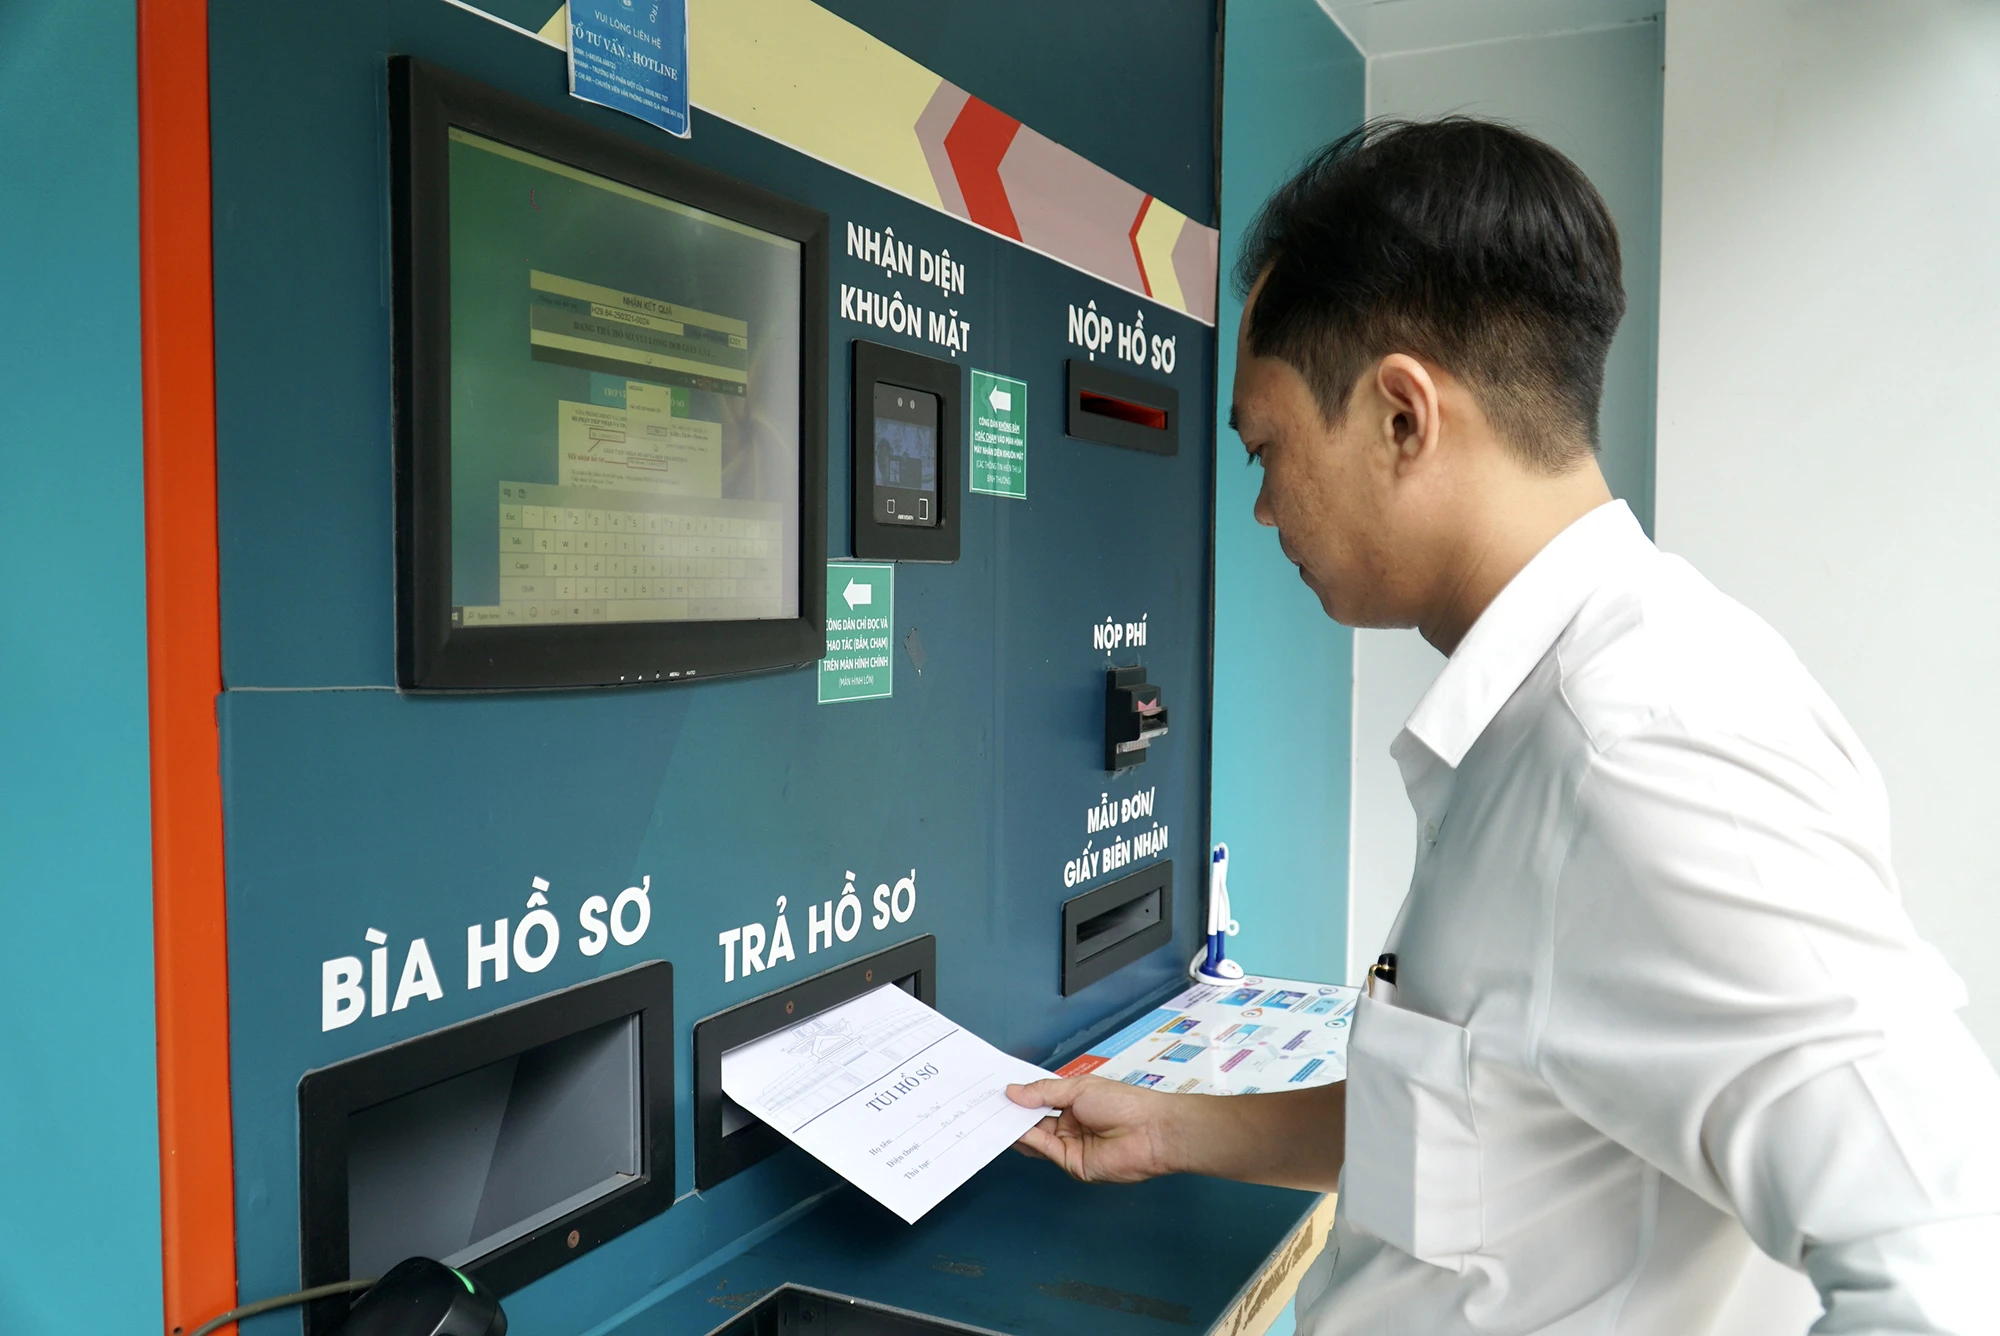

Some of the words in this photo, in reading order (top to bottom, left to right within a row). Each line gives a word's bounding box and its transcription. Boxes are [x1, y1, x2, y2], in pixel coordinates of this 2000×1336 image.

[594, 10, 608, 24] VUI
[610, 16, 632, 35] LÒNG
[633, 27, 650, 43] LIÊN
[586, 30, 602, 47] TƯ
[603, 38, 625, 58] VẤN
[633, 50, 678, 81] HOTLINE
[847, 221, 913, 278] NHẬN
[920, 248, 965, 297] DIỆN
[840, 284, 922, 338] KHUÔN
[928, 308, 970, 357] MẶT
[1068, 300, 1113, 362] NỘP
[1118, 310, 1147, 366] HỒ
[1151, 335, 1176, 374] SƠ
[506, 512, 515, 520] Esc
[512, 537, 521, 545] Tab
[515, 562, 529, 570] Caps
[842, 636, 853, 651] TÁC
[854, 634, 869, 652] (BẤM,
[870, 636, 888, 651] CHẠM)
[843, 617, 855, 630] DÂN
[856, 616, 867, 630] CHỈ
[867, 618, 879, 632] ĐỌC
[880, 616, 888, 629] VÀ
[1094, 616, 1123, 656] NỘP
[1126, 612, 1148, 648] PHÍ
[823, 659, 839, 672] TRÊN
[840, 656, 854, 670] MÀN
[854, 656, 869, 669] HÌNH
[870, 654, 888, 668] CHÍNH
[839, 676, 851, 688] (MÀN
[1087, 792, 1118, 834] MẪU
[1121, 786, 1155, 817] ĐƠN/
[1063, 840, 1100, 888] GIẤY
[1102, 835, 1130, 870] BIÊN
[1134, 822, 1168, 860] NHẬN
[718, 895, 796, 984] TRẢ
[808, 870, 862, 954] HỒ
[872, 868, 916, 931] SƠ
[322, 927, 444, 1032] BÌA
[467, 876, 560, 990] HỒ
[578, 875, 651, 957] SƠ
[865, 1090, 900, 1112] TÚI
[893, 1072, 920, 1095] HỒ
[915, 1062, 940, 1080] SƠ
[868, 1146, 882, 1156] Họ
